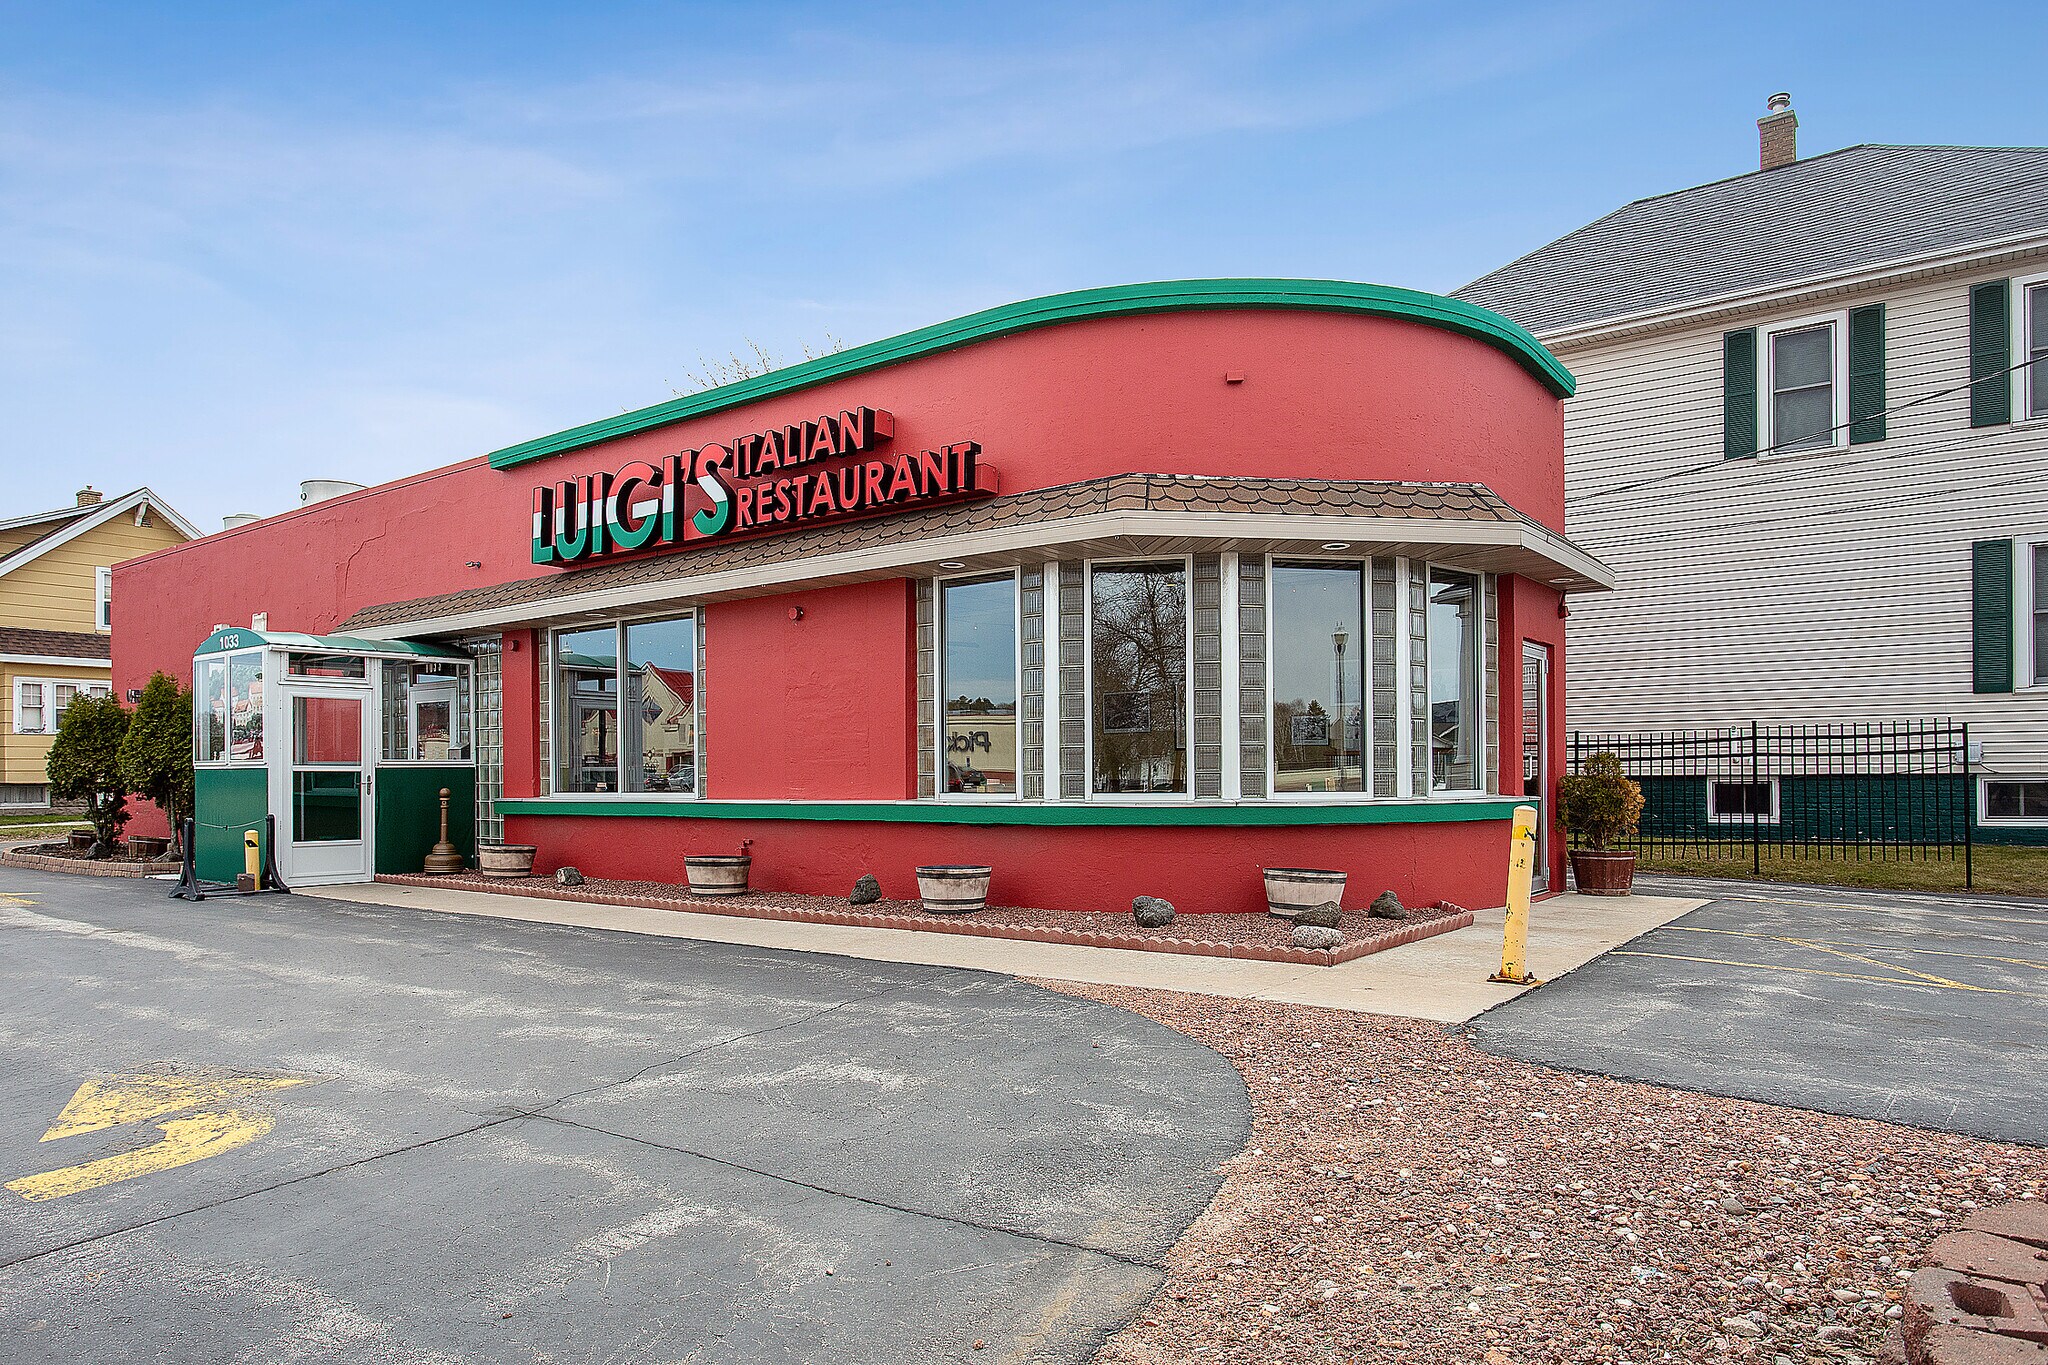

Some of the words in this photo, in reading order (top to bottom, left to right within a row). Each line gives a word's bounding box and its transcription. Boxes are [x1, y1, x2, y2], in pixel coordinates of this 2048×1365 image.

[733, 406, 870, 478] ITALIAN
[531, 442, 732, 564] LUIGI'S
[736, 440, 977, 528] RESTAURANT
[219, 634, 240, 650] 1033
